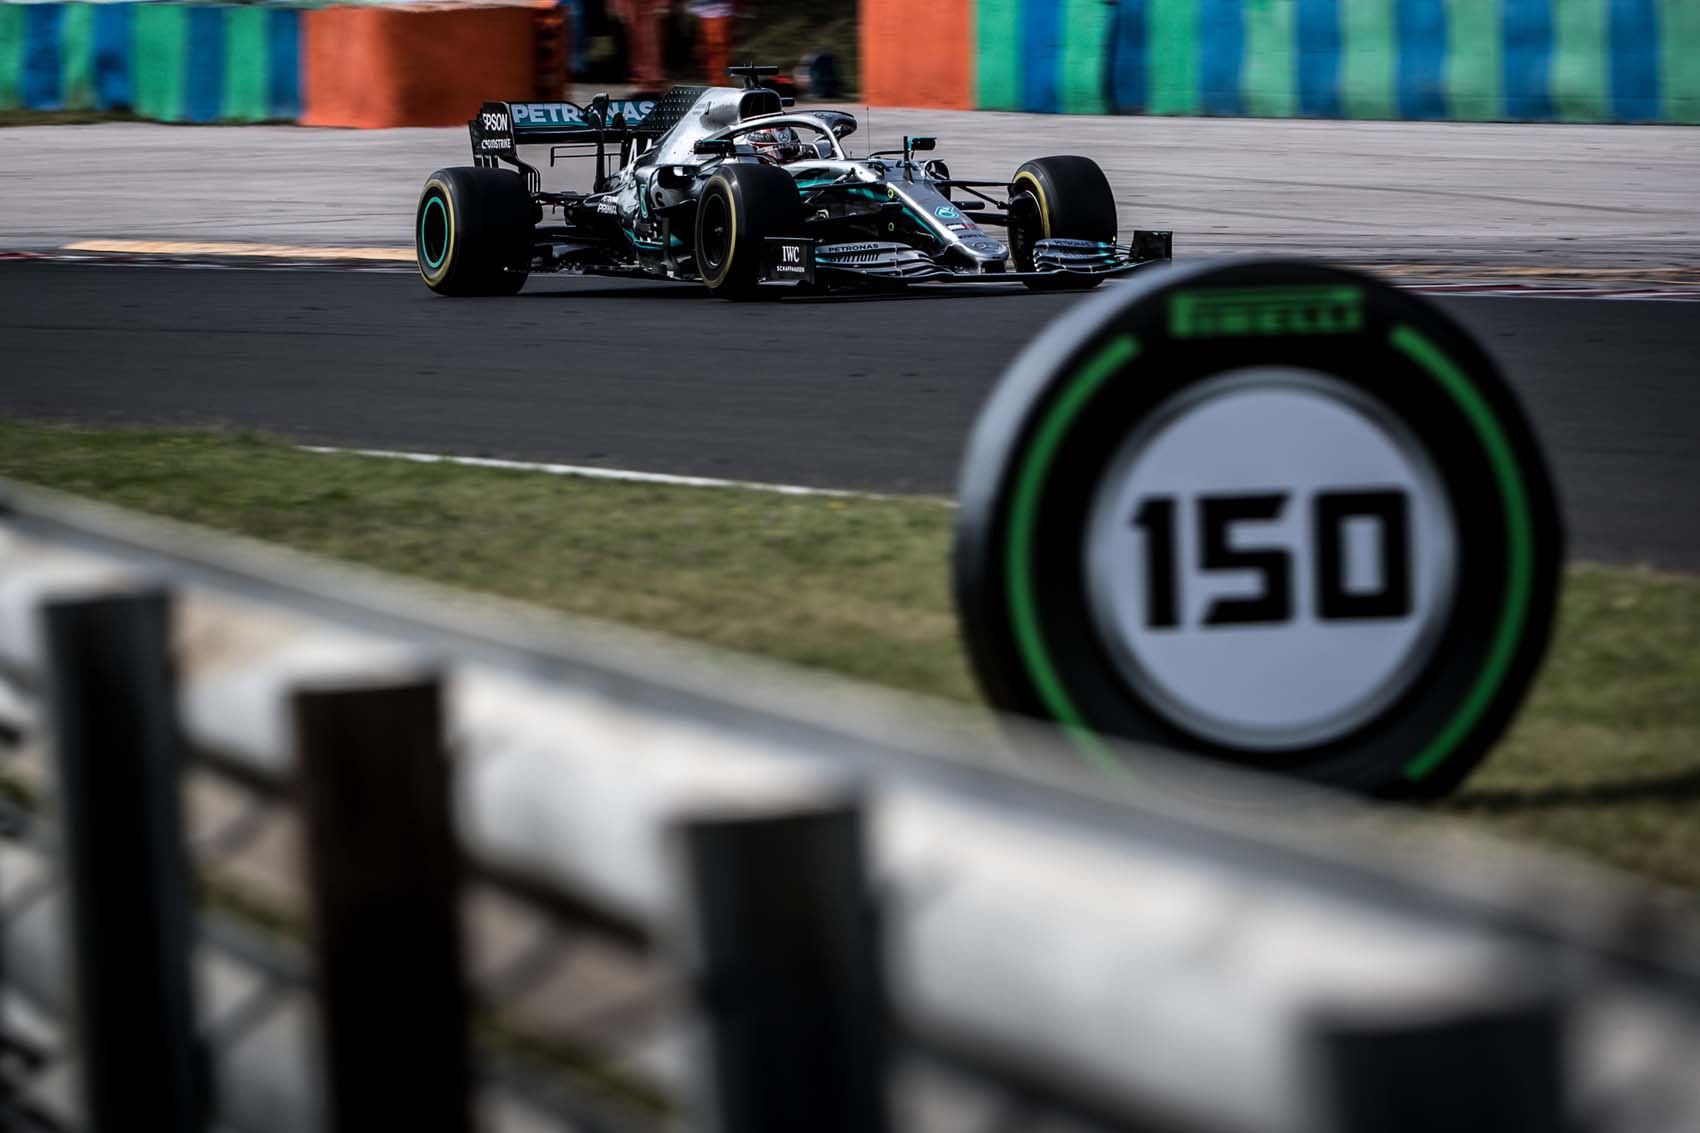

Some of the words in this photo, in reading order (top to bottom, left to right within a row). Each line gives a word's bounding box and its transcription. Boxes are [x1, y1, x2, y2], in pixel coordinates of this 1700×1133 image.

[511, 102, 654, 123] PETRNAS
[782, 245, 800, 263] IWC
[828, 243, 880, 253] PETRONAS
[1131, 486, 1413, 632] 150
